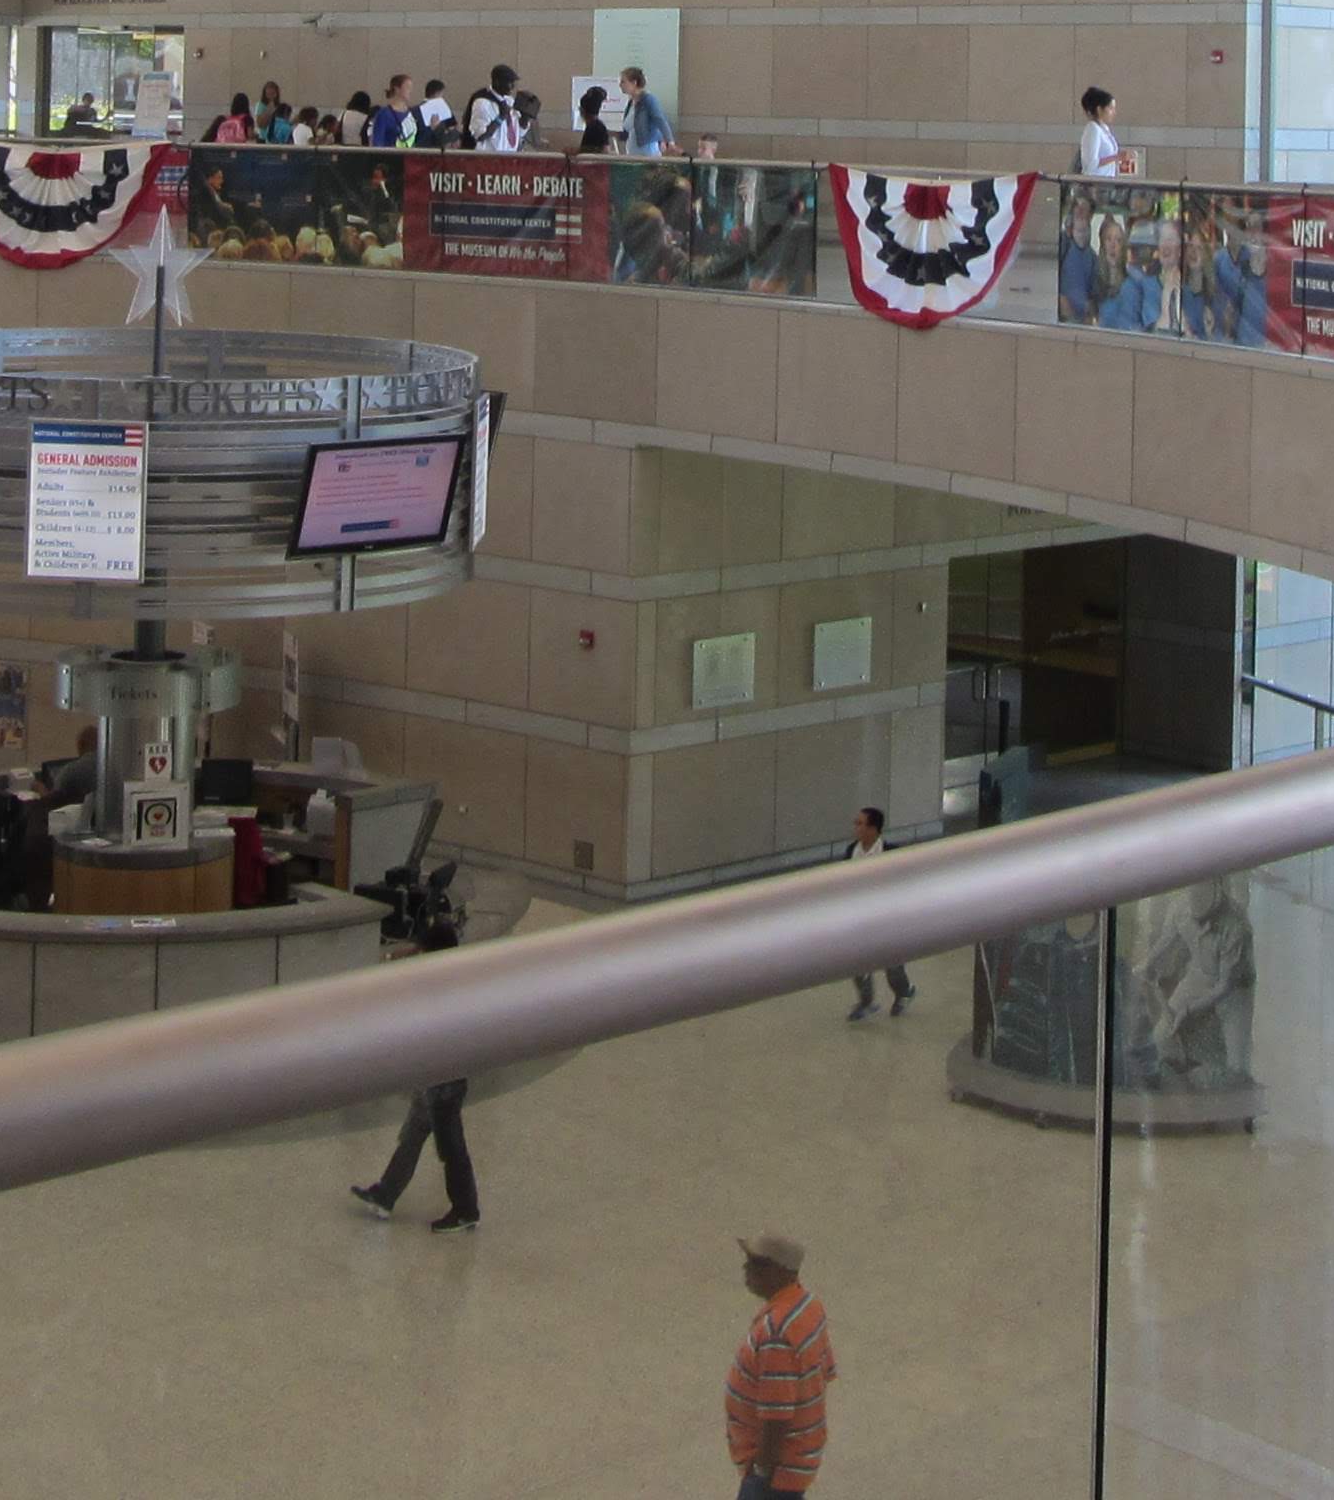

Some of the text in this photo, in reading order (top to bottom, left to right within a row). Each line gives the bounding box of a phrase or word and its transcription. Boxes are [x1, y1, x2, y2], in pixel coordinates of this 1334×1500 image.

[430, 172, 584, 198] VISIT LEARN DEBATE
[471, 216, 522, 227] CONSTITUTION
[525, 217, 551, 228] CENTER
[1292, 219, 1327, 248] VISIT
[445, 242, 459, 256] THE
[461, 243, 497, 258] MUSEUM
[498, 246, 508, 259] OF
[1307, 317, 1320, 335] THE
[137, 378, 317, 416] TICKETS
[37, 452, 138, 468] GENERAL ADMISSION
[37, 482, 64, 491] Adults
[36, 497, 67, 506] Seniors
[88, 499, 95, 507] &
[36, 508, 70, 516] Students
[35, 523, 72, 532] Children
[35, 549, 60, 558] Active
[43, 561, 79, 569] Children
[107, 561, 134, 571] FREE
[110, 686, 158, 700] Tickets
[148, 745, 168, 755] AED
